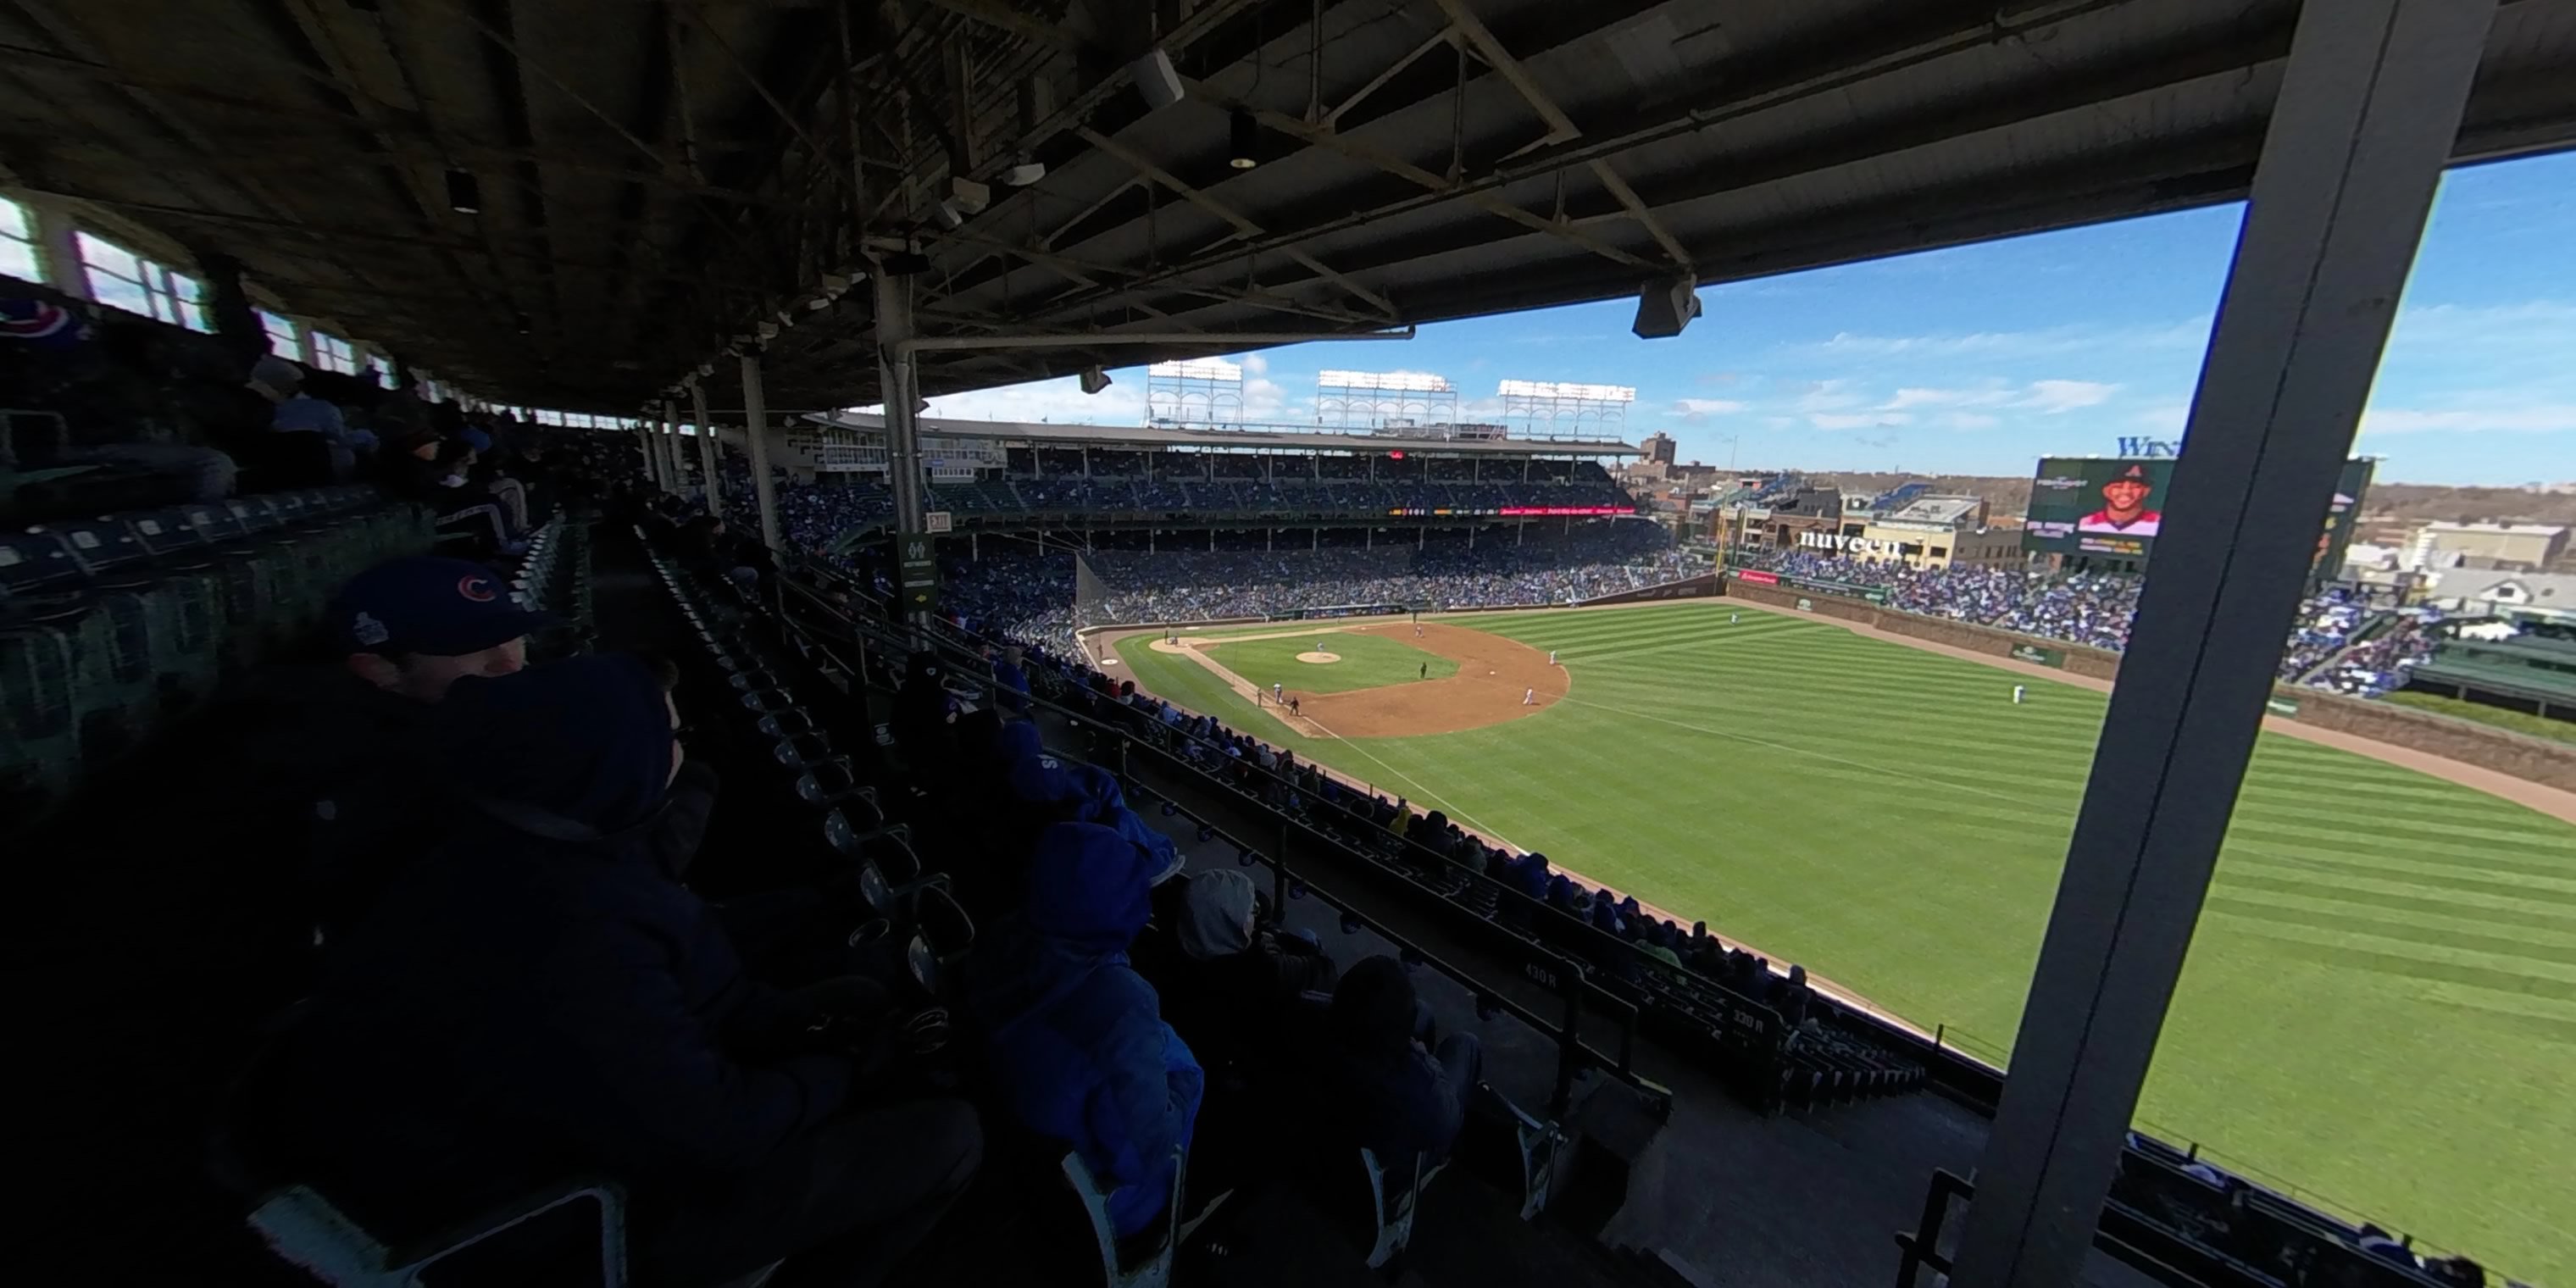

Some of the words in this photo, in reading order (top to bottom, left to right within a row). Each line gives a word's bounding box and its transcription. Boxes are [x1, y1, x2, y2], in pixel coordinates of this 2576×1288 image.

[1799, 530, 1902, 558] nuveen
[1525, 963, 1546, 983] 430
[1548, 974, 1557, 989] R
[1733, 1009, 1754, 1028] 330
